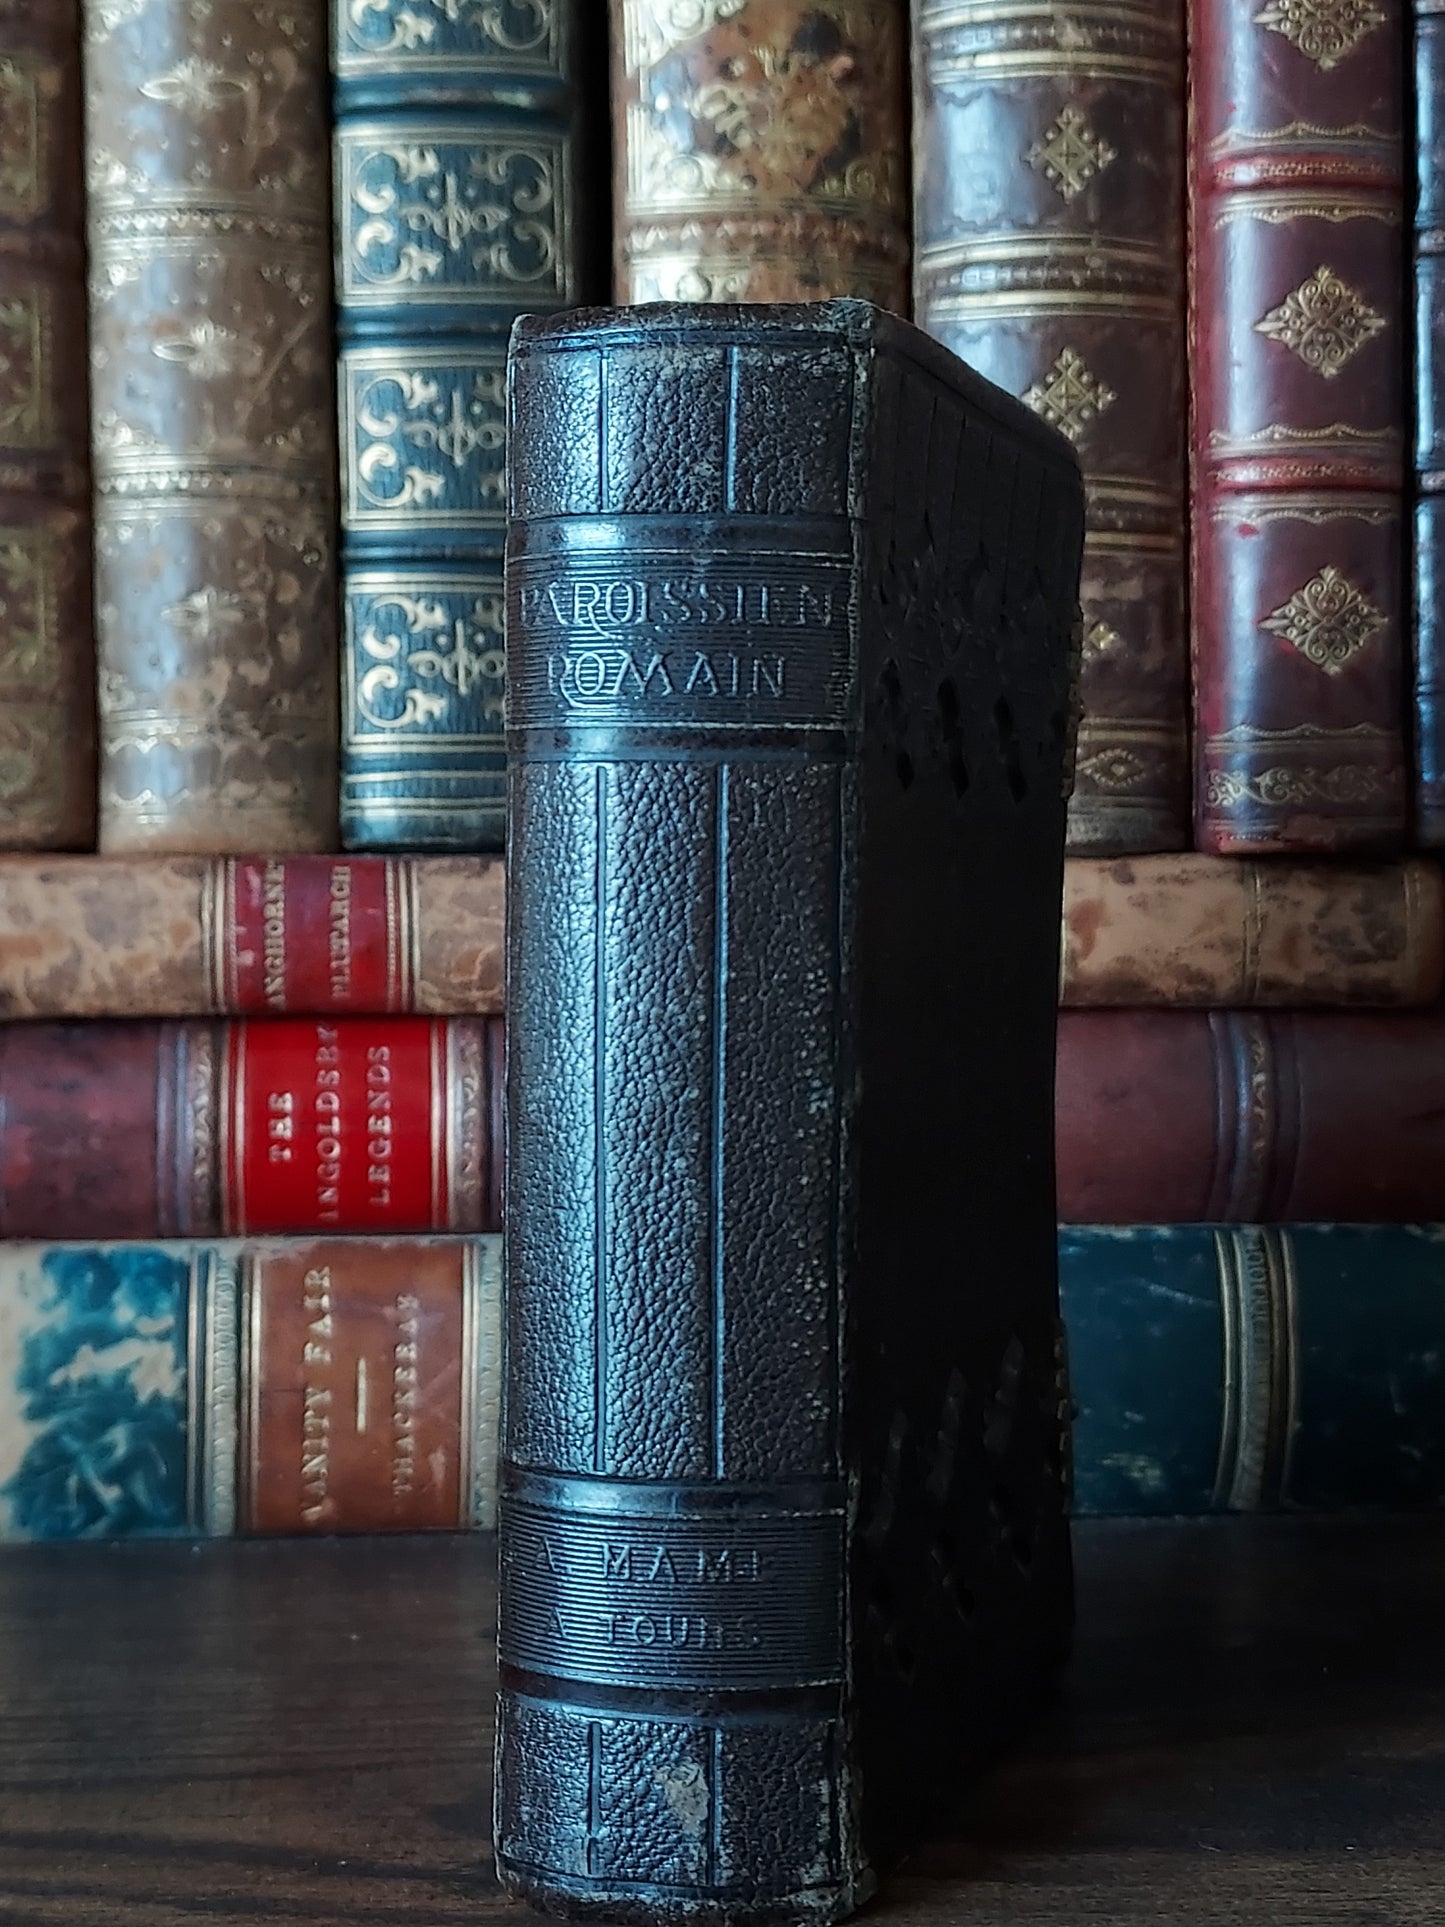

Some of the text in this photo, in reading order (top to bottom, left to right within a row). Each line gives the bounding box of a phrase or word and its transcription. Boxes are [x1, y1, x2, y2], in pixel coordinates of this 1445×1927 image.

[548, 650, 785, 707] ROMAIN
[268, 1091, 293, 1163] THE
[315, 1023, 341, 1222] INGOLDSBY
[367, 1045, 392, 1206] LEGENDS
[301, 1266, 332, 1522] VANITY FAIR
